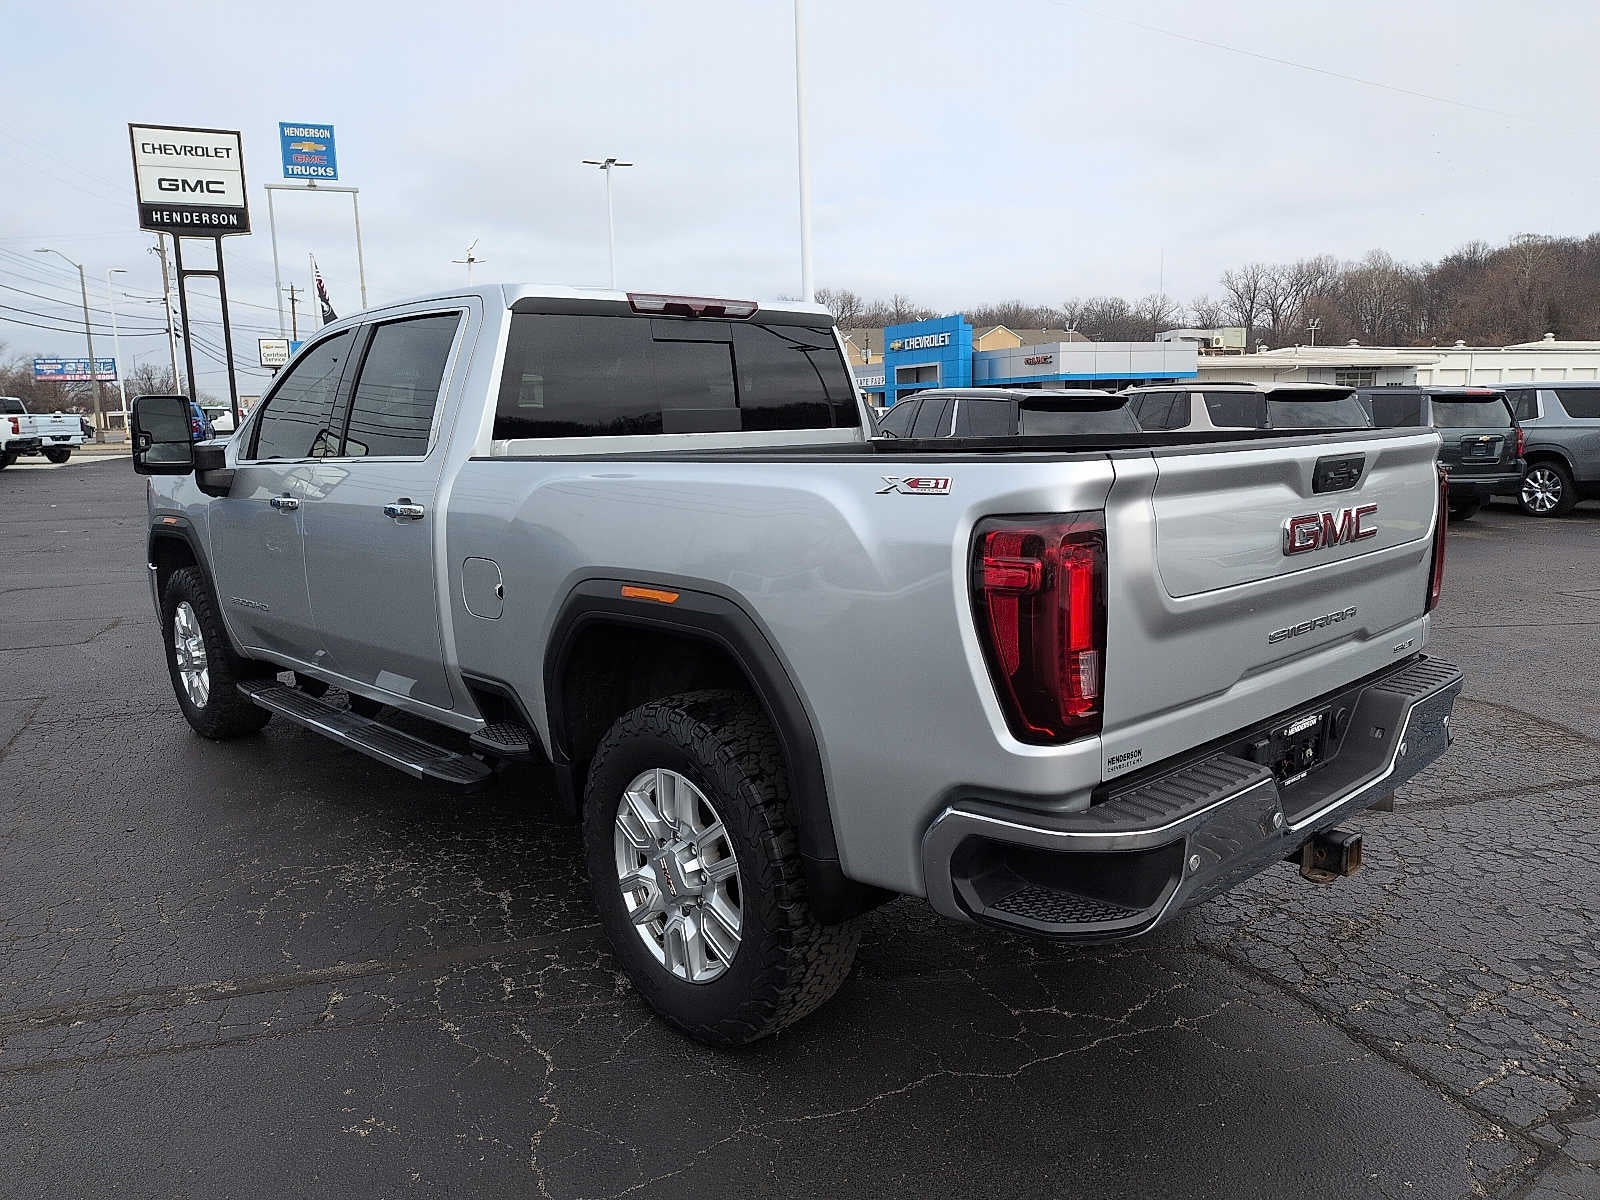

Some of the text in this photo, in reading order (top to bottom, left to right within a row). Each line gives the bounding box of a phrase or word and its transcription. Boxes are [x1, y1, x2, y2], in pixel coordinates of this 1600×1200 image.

[284, 127, 331, 139] HENDERSON
[141, 142, 232, 159] CHEVROLET
[292, 154, 328, 164] GMC
[286, 165, 335, 177] TRUCKS
[157, 177, 226, 195] GMC
[152, 210, 238, 225] HENDERSON
[904, 332, 951, 350] CHEVROLET
[1281, 502, 1378, 556] GMC
[1269, 606, 1357, 644] SIERRA
[1107, 748, 1142, 766] HENDERSON
